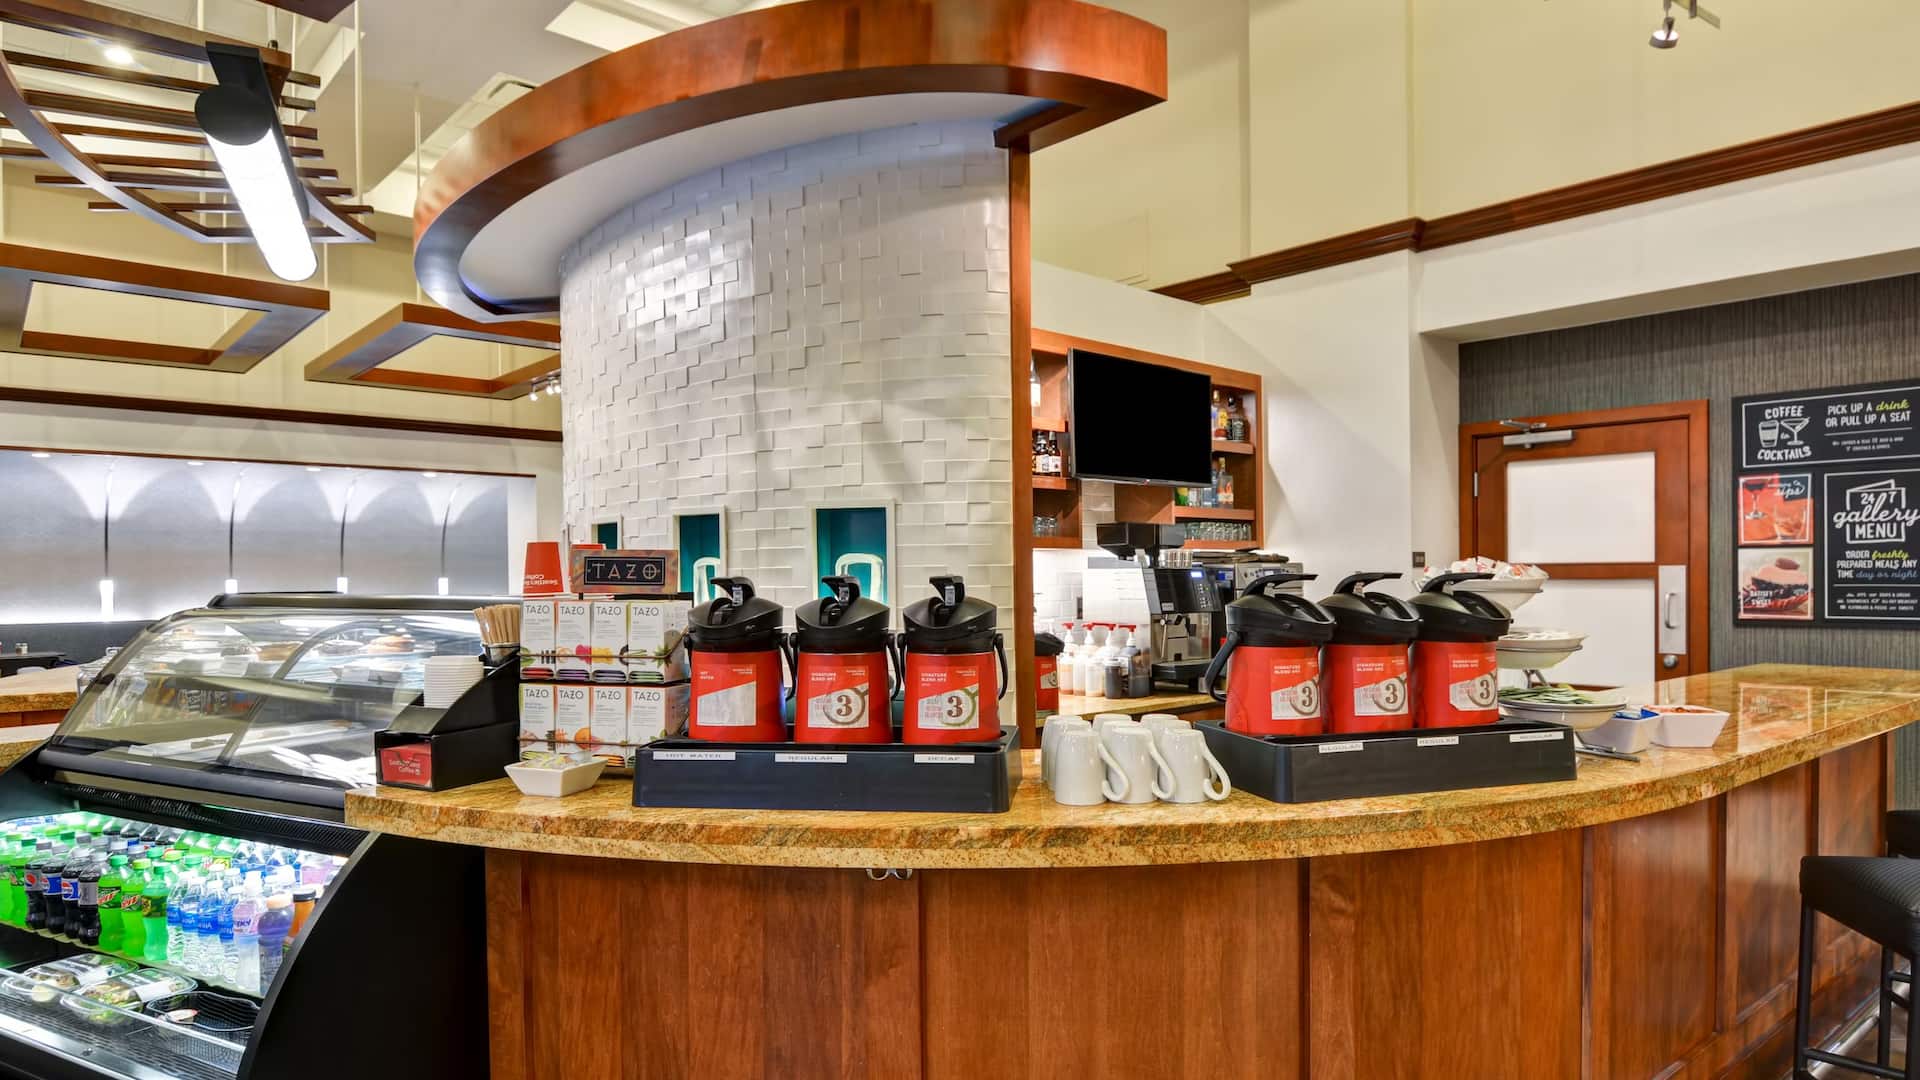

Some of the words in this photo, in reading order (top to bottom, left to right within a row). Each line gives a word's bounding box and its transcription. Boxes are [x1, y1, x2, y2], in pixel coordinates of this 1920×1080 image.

[1764, 405, 1804, 419] COFFEE
[1827, 404, 1848, 416] PICK
[1850, 402, 1864, 414] UP
[1866, 402, 1873, 412] A
[1875, 399, 1910, 411] drink
[1825, 417, 1838, 428] OR
[1840, 415, 1862, 427] PULL
[1864, 414, 1877, 424] UP
[1879, 413, 1887, 423] A
[1889, 411, 1911, 422] SEAT
[1757, 446, 1812, 461] COCKTAILS
[1832, 492, 1920, 529] gallery
[1855, 522, 1897, 539] MENU
[1845, 550, 1870, 559] ORDER
[592, 563, 657, 579] TAZO
[1836, 559, 1873, 569] PREPARED
[1875, 559, 1900, 569] MEALS
[1901, 559, 1918, 569] ANY
[1837, 569, 1854, 579] TIME
[525, 604, 550, 615] TAZO
[560, 605, 585, 616] TAZO
[596, 606, 622, 617] TAZO
[632, 606, 659, 617] TAZO
[525, 688, 550, 698] TAZO
[559, 689, 584, 700] TAZO
[595, 690, 622, 701] TAZO
[633, 691, 661, 702] TAZO
[1301, 686, 1313, 707] 3
[1385, 683, 1399, 704] 3
[1479, 679, 1491, 700] 3
[836, 694, 853, 717] 3
[947, 695, 964, 718] 3
